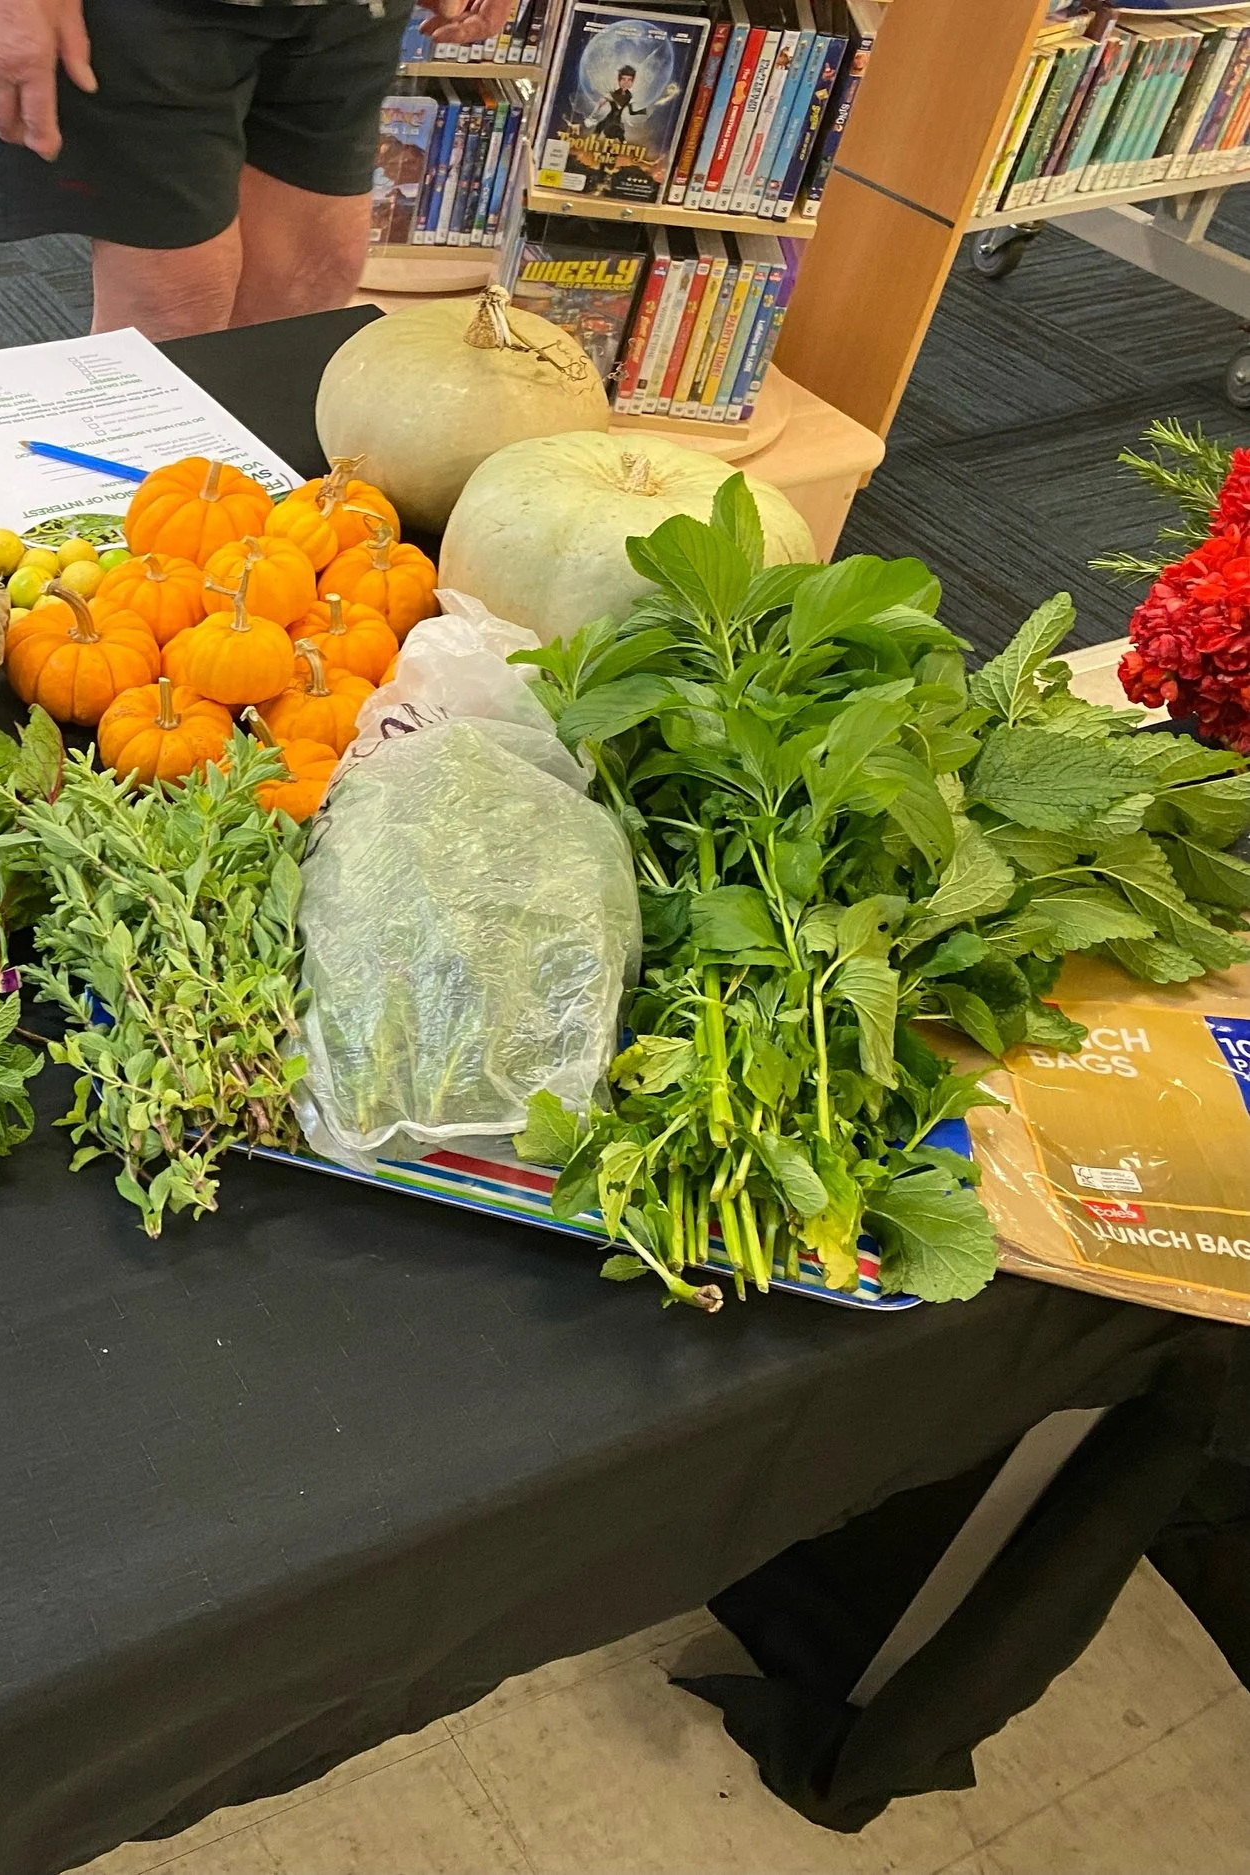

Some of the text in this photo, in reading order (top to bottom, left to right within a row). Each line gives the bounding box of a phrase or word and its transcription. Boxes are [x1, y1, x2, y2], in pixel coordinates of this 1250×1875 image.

[603, 138, 648, 163] Fairy
[521, 259, 639, 284] WHEELY
[23, 500, 85, 519] INTEREST
[1026, 1049, 1138, 1078] BAGS
[1095, 1222, 1250, 1261] LUNCH BAG
